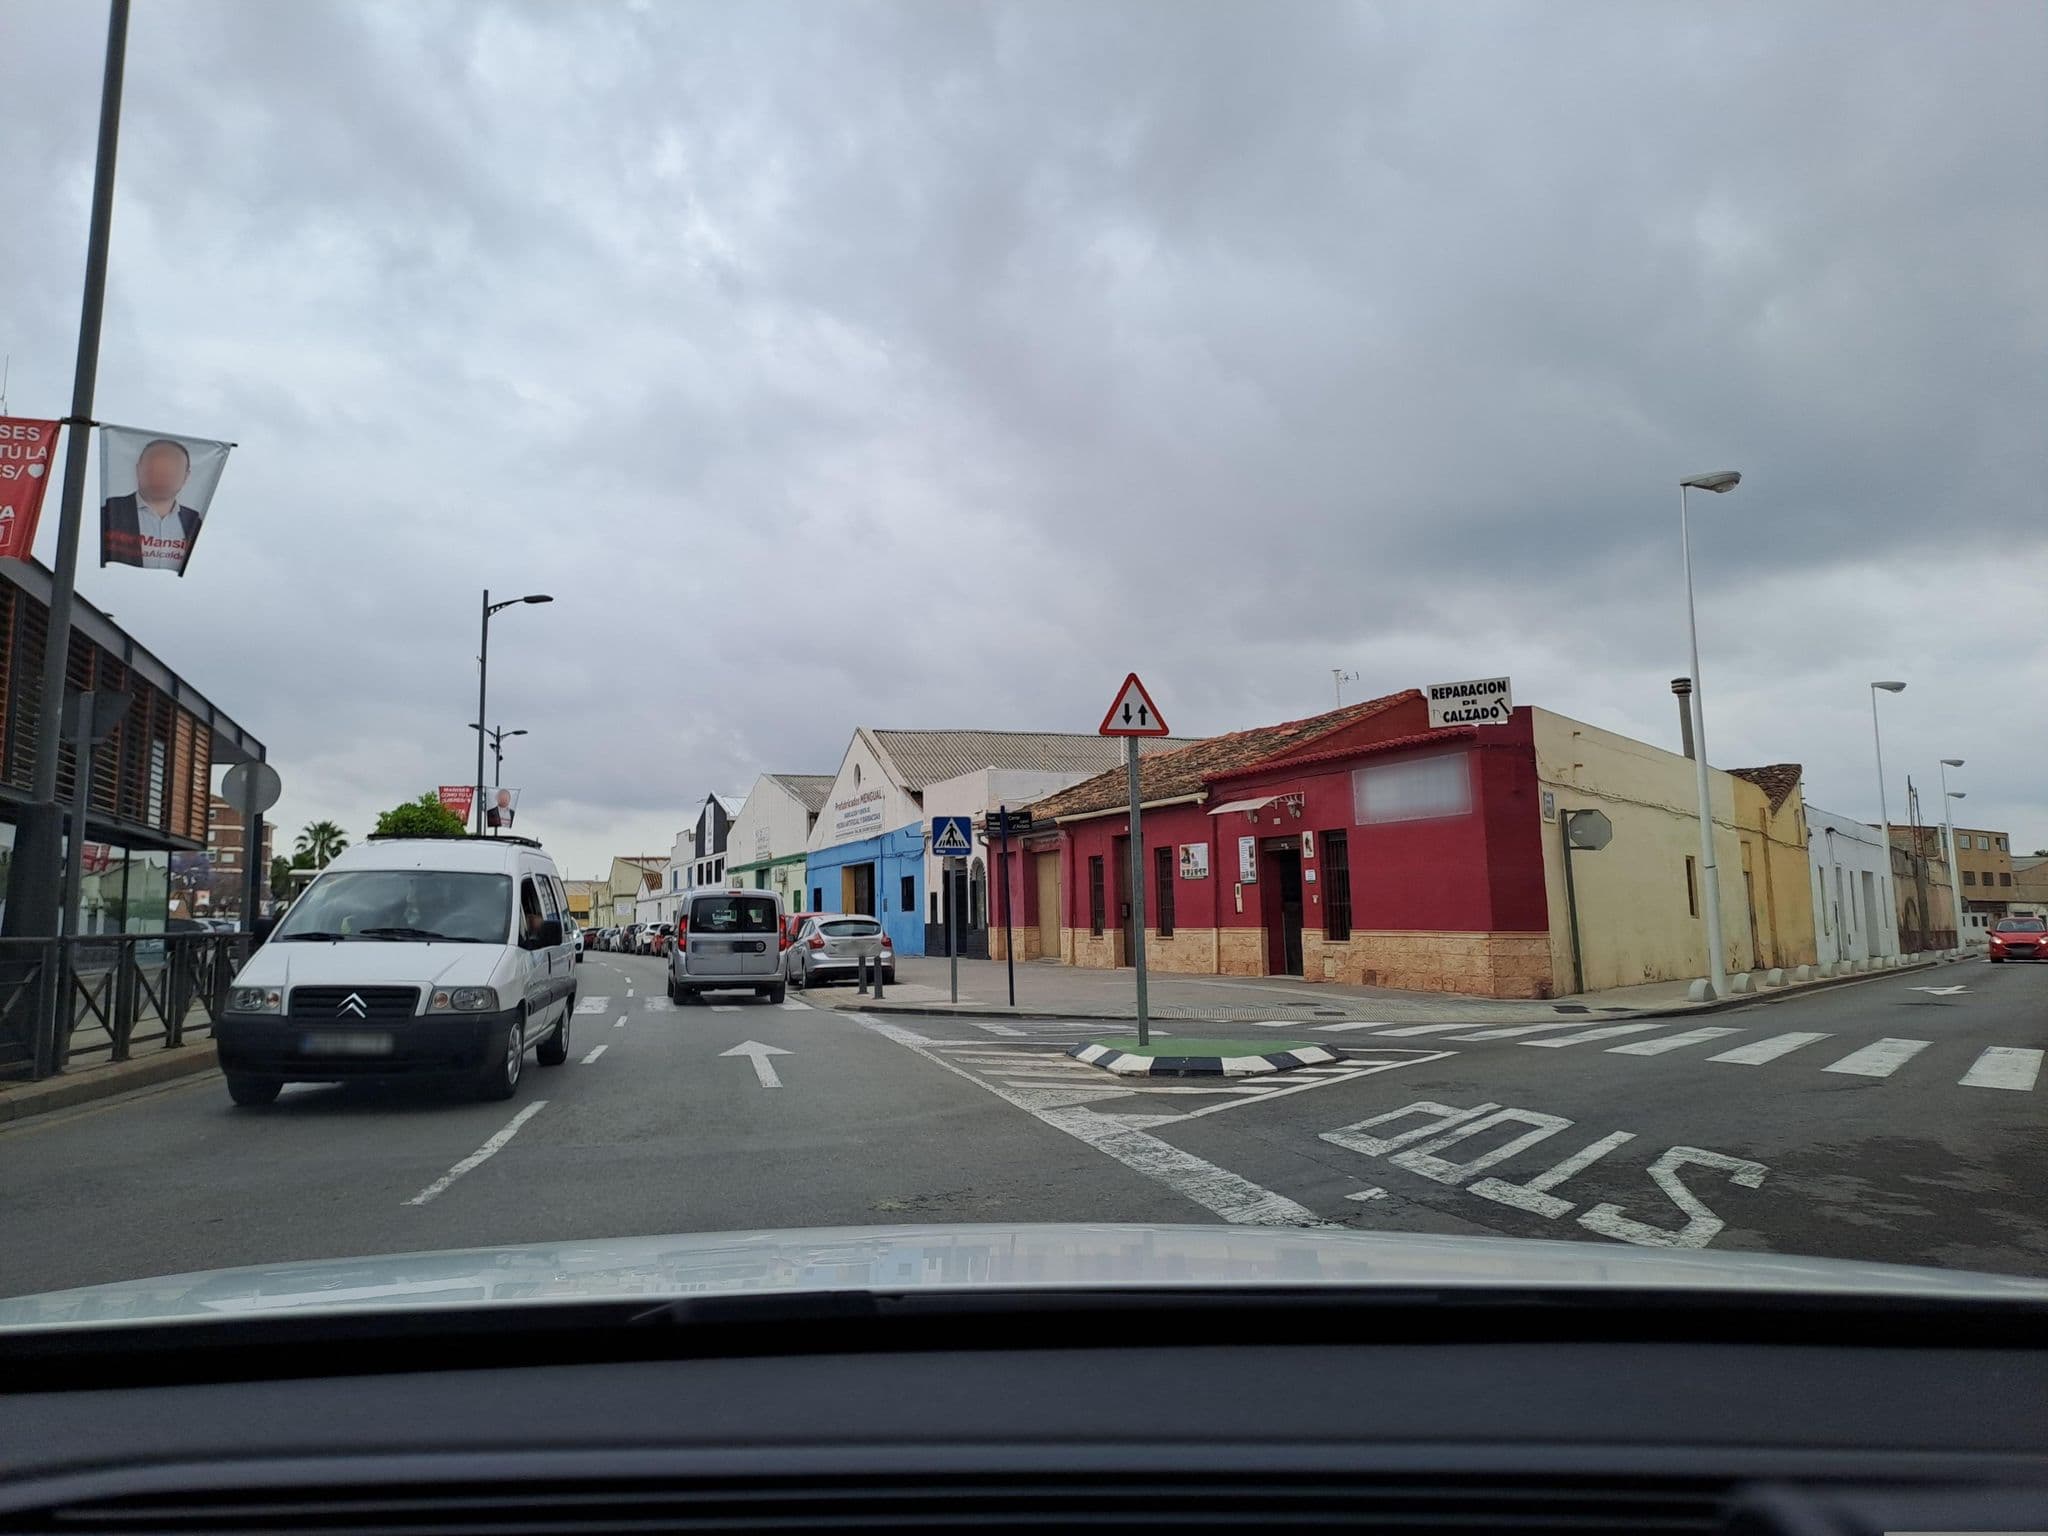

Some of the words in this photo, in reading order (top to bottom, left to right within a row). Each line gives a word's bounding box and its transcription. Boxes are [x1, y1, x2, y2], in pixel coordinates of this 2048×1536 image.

[26, 446, 48, 459] LA
[1431, 681, 1507, 700] REPARACION
[1443, 706, 1500, 723] CALZADO
[1318, 1100, 1769, 1249] STOP
